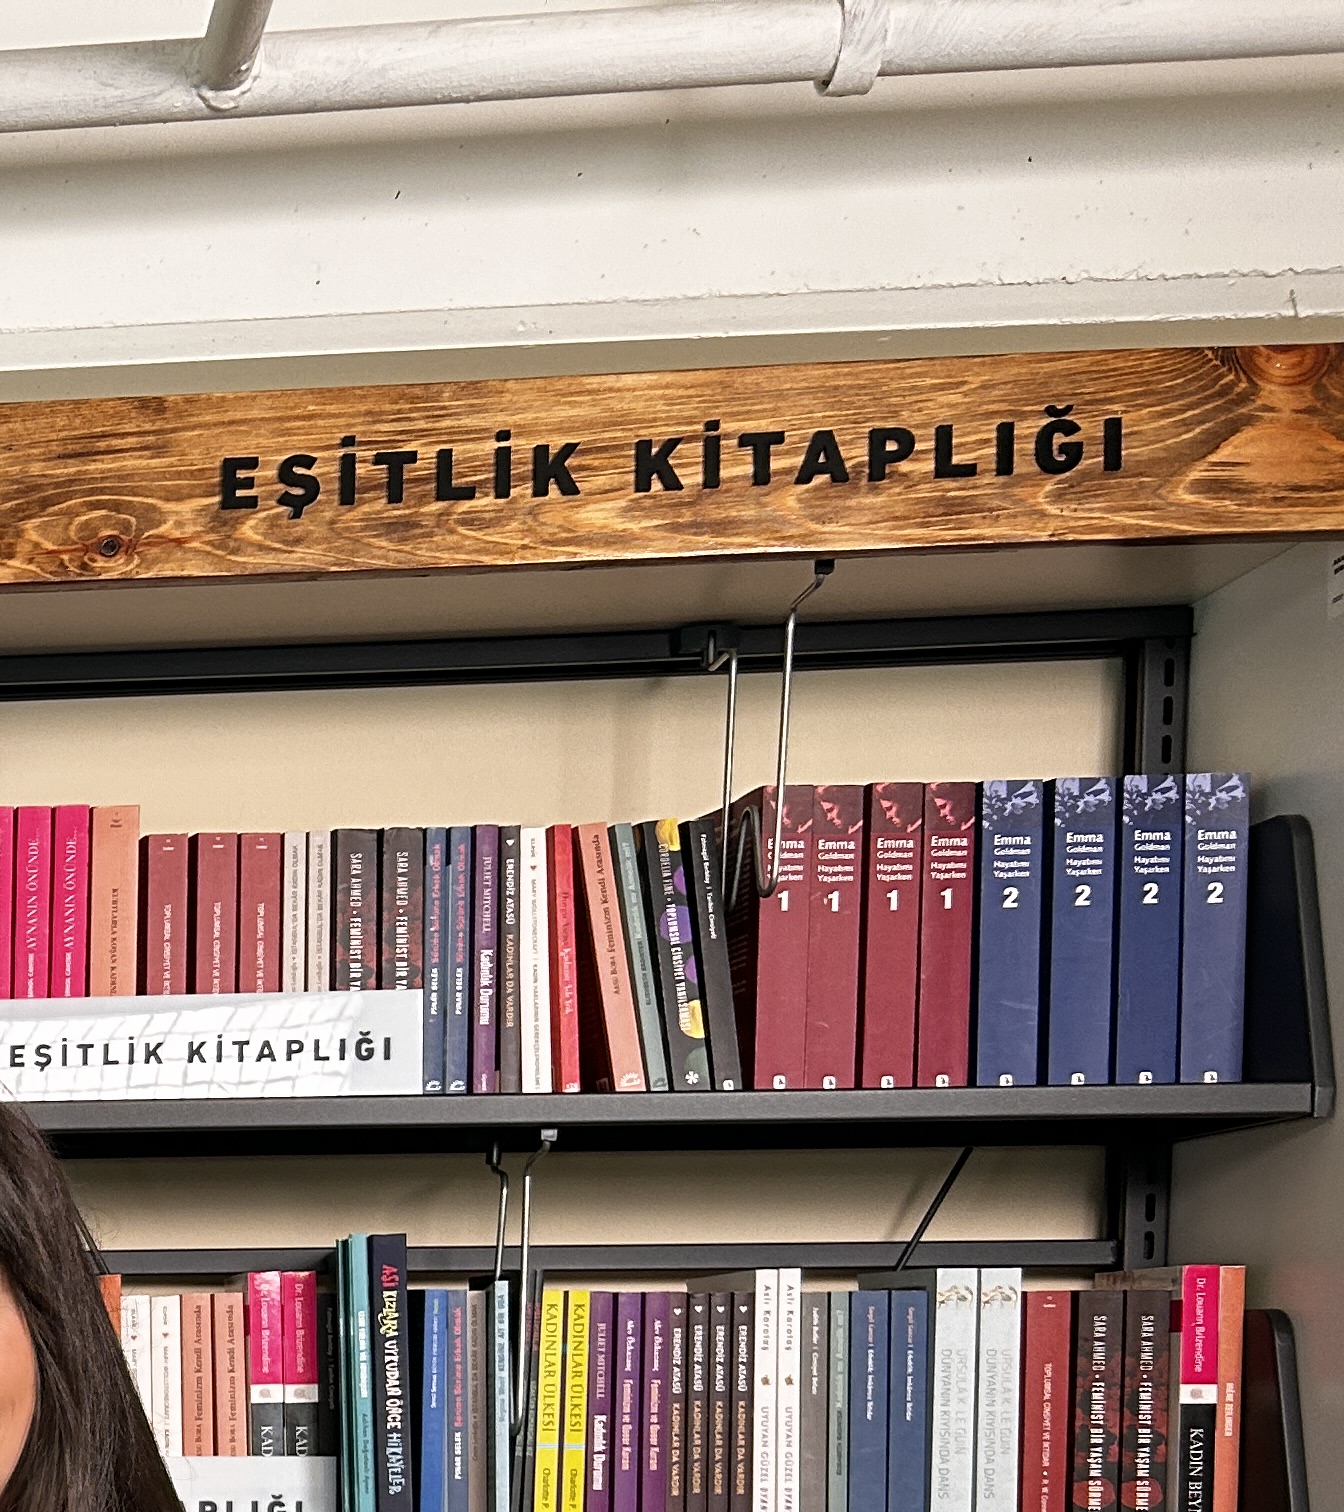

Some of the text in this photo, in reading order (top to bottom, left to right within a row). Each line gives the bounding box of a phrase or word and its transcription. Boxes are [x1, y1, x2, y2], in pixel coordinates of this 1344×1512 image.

[217, 399, 1125, 520] EŞİTLİK KİTAPLIĞI
[877, 838, 914, 849] Emma
[931, 836, 967, 847] Emma
[994, 834, 1031, 845] Emma
[1197, 830, 1236, 841] Emma
[505, 859, 515, 896] ERENDİZ
[887, 890, 899, 911] 1
[941, 889, 952, 909] 1
[1003, 888, 1018, 908] 2
[1208, 883, 1223, 903] 2
[505, 898, 515, 924] ATASÜ
[480, 856, 493, 1024] JULIET MITCHELL Kadınlık Durumu
[506, 934, 514, 979] KADINLAR
[506, 981, 514, 993] DA
[10, 1030, 391, 1072] EŞİTLİK KİTAPLIĞI
[1196, 1278, 1205, 1291] Dr.
[378, 1291, 400, 1337] KIZLARA
[1195, 1293, 1205, 1324] Louann
[1141, 1316, 1153, 1338] SARA
[384, 1340, 400, 1395] UYKUDAN
[569, 1303, 585, 1432] KADINLAR ÜLKESİ
[1140, 1341, 1152, 1370] AHMED
[385, 1399, 403, 1429] ÖNCE
[1138, 1382, 1152, 1424] FEMİNİST
[1137, 1428, 1152, 1444] BİR
[1134, 1447, 1150, 1476] YAŞAM
[1189, 1428, 1204, 1476] KADIN
